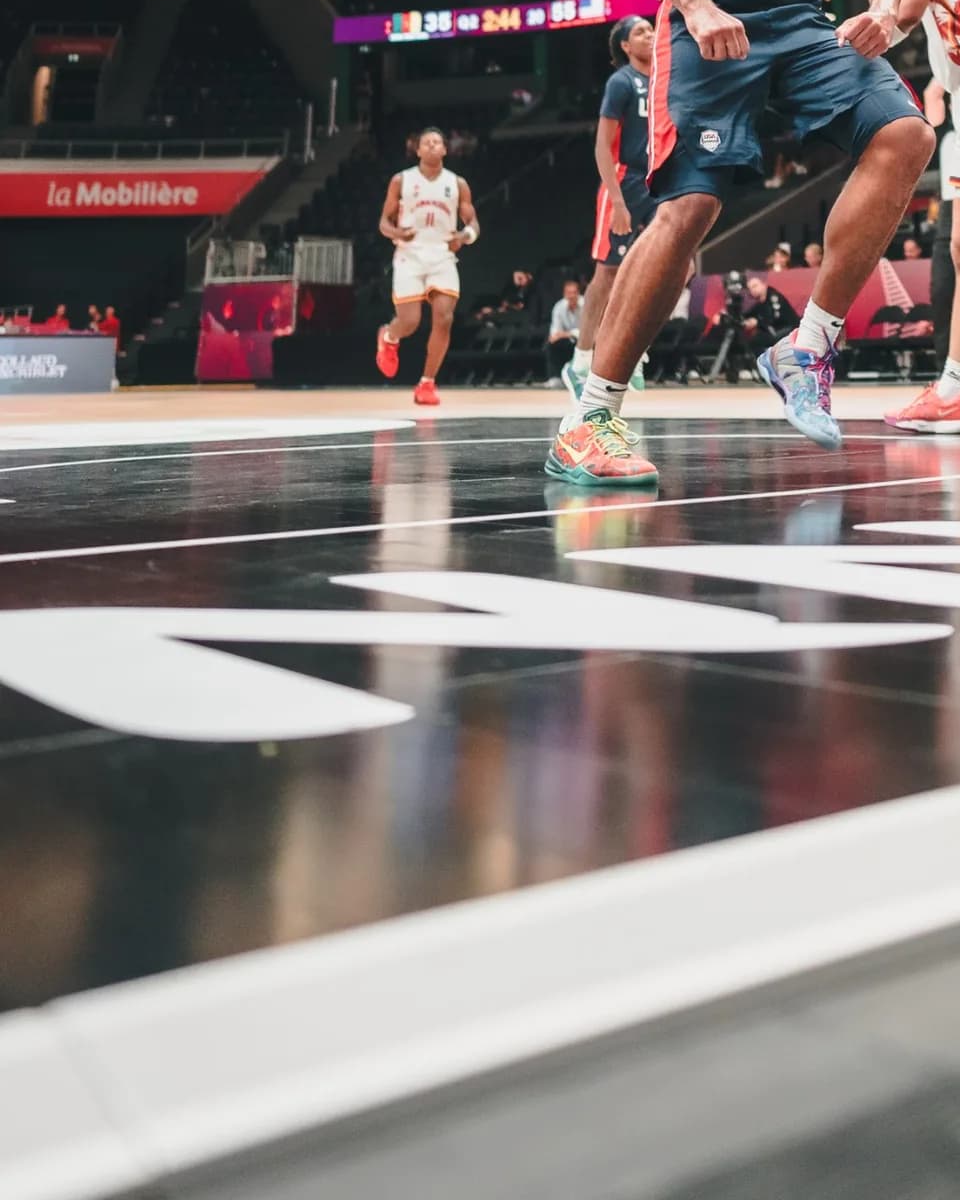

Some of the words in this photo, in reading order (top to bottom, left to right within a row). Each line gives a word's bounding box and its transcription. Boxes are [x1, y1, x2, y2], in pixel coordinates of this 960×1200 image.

[424, 10, 453, 32] 35
[47, 181, 71, 207] la
[76, 181, 198, 207] Mobilière
